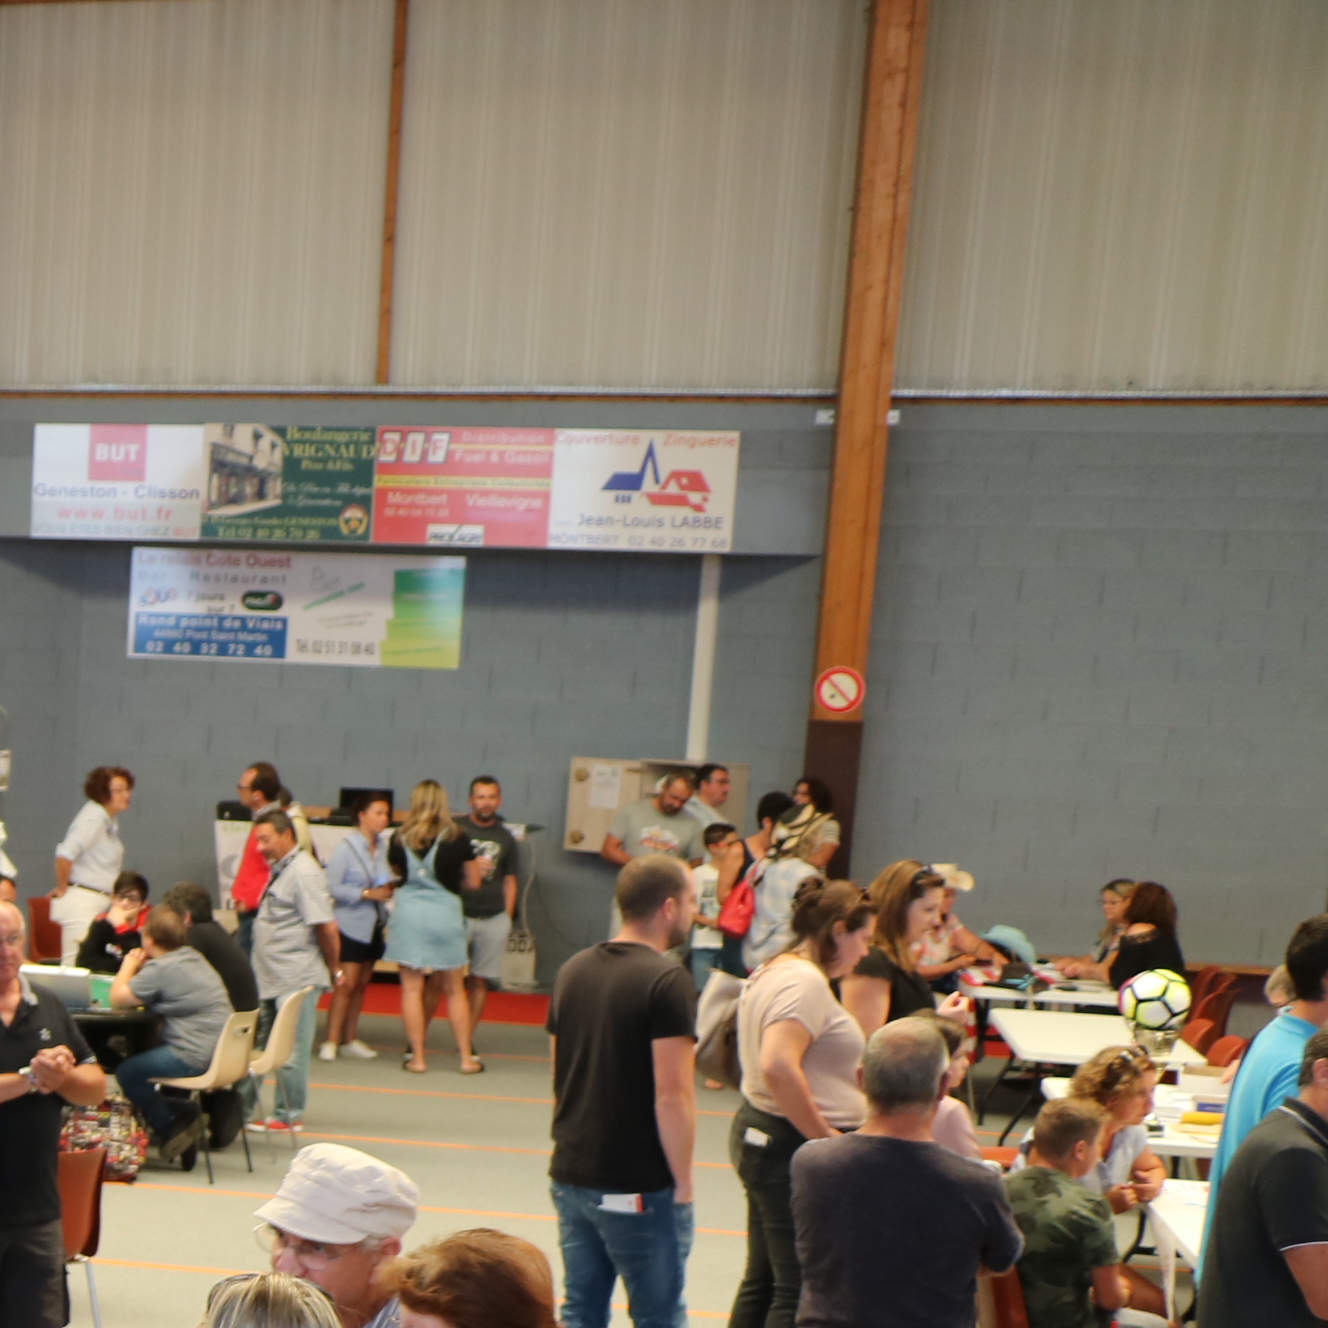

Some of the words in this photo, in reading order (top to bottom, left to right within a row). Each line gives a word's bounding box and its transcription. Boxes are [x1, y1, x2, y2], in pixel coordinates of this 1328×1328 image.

[555, 431, 641, 446] Couverture
[663, 432, 738, 448] Zinguerie
[95, 443, 140, 463] BUT
[454, 449, 486, 463] Fuel
[34, 482, 118, 499] Geneston
[135, 484, 201, 500] Clisson
[387, 491, 448, 507] Montbert
[56, 505, 174, 521] www.but.fr
[577, 512, 665, 529] Jean-Louis
[671, 514, 724, 530] LABBE
[172, 526, 199, 538] BUT
[549, 532, 620, 546] MONTBERT
[628, 535, 644, 546] 02
[649, 535, 666, 547] 40
[670, 537, 686, 548] 26
[689, 537, 707, 549] 77
[711, 537, 728, 549] 68
[160, 552, 202, 566] relais
[245, 553, 292, 568] Ouest
[189, 569, 287, 584] Restaurant
[138, 614, 177, 626] Rond
[180, 615, 219, 629] point
[222, 617, 242, 629] de
[245, 618, 284, 630] Viais
[146, 640, 165, 653] 02
[173, 641, 192, 654] 40
[227, 643, 246, 656] 72
[253, 644, 274, 657] 40
